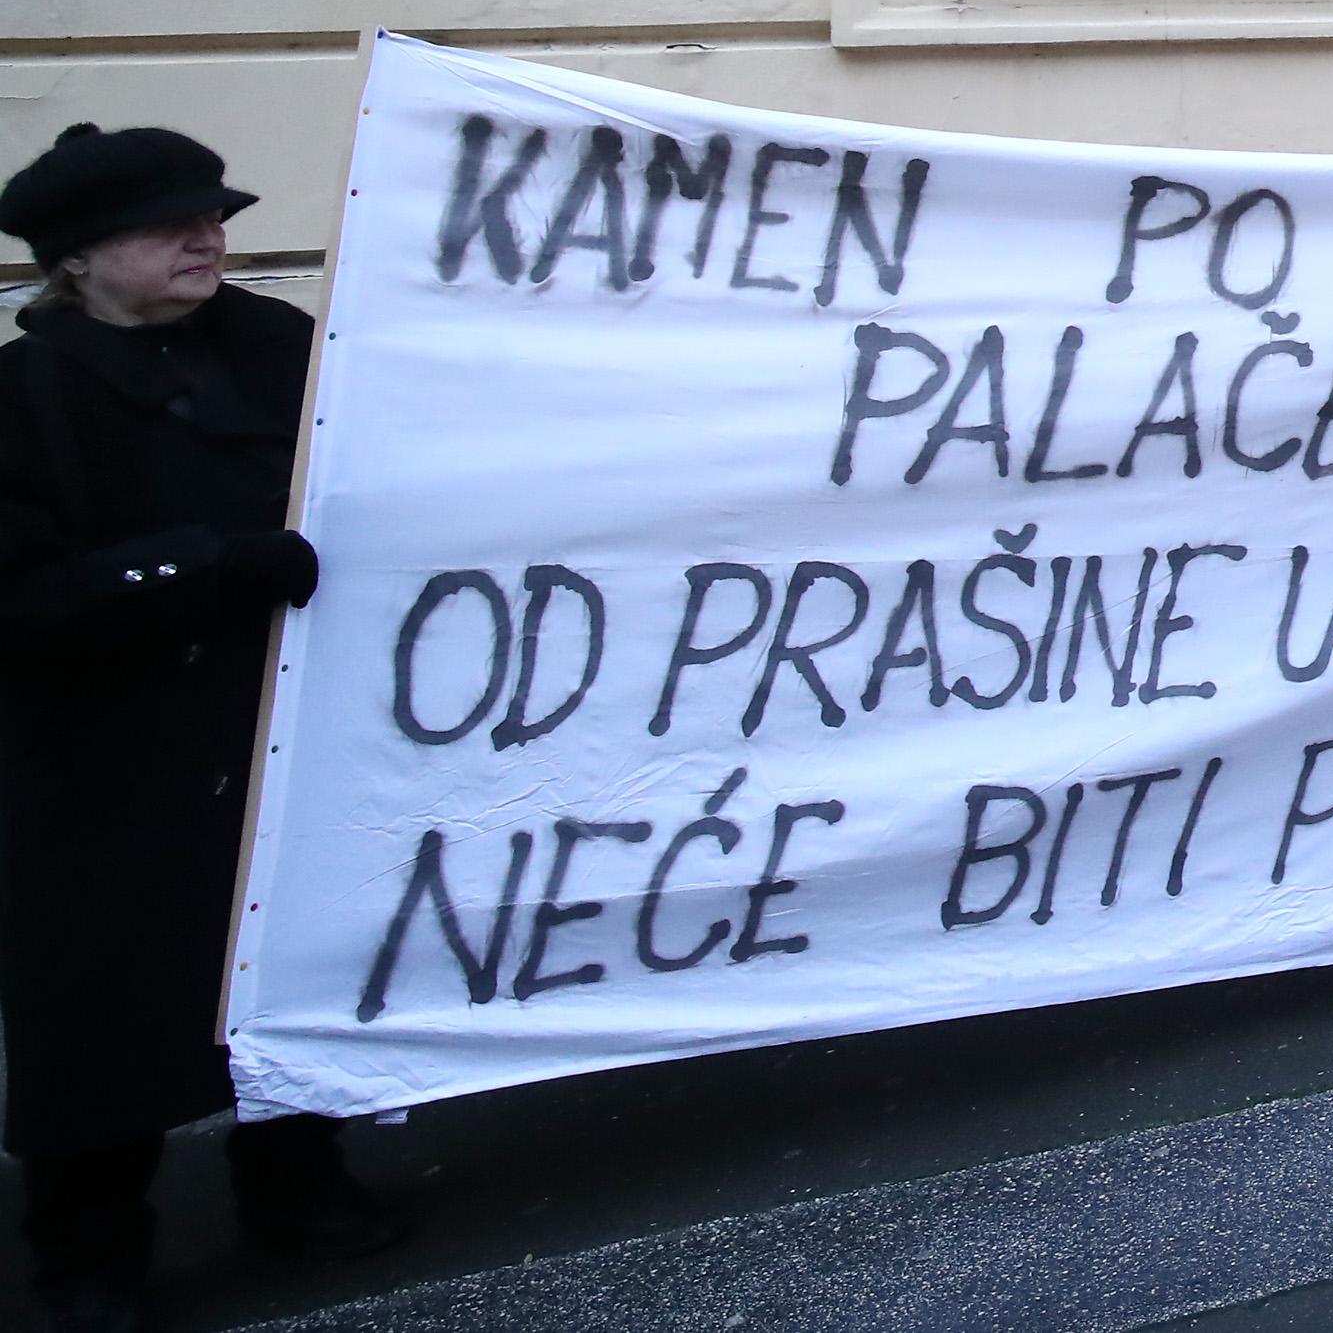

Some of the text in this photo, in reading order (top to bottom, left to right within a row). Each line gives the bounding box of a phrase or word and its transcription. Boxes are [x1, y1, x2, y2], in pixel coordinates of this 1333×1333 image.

[433, 112, 933, 307] KAMEN
[1105, 175, 1296, 310] PO
[393, 562, 607, 752] OD
[648, 523, 1248, 737] PRAŠINE
[355, 767, 845, 1023] NEĆE
[941, 757, 1224, 930] BITI
